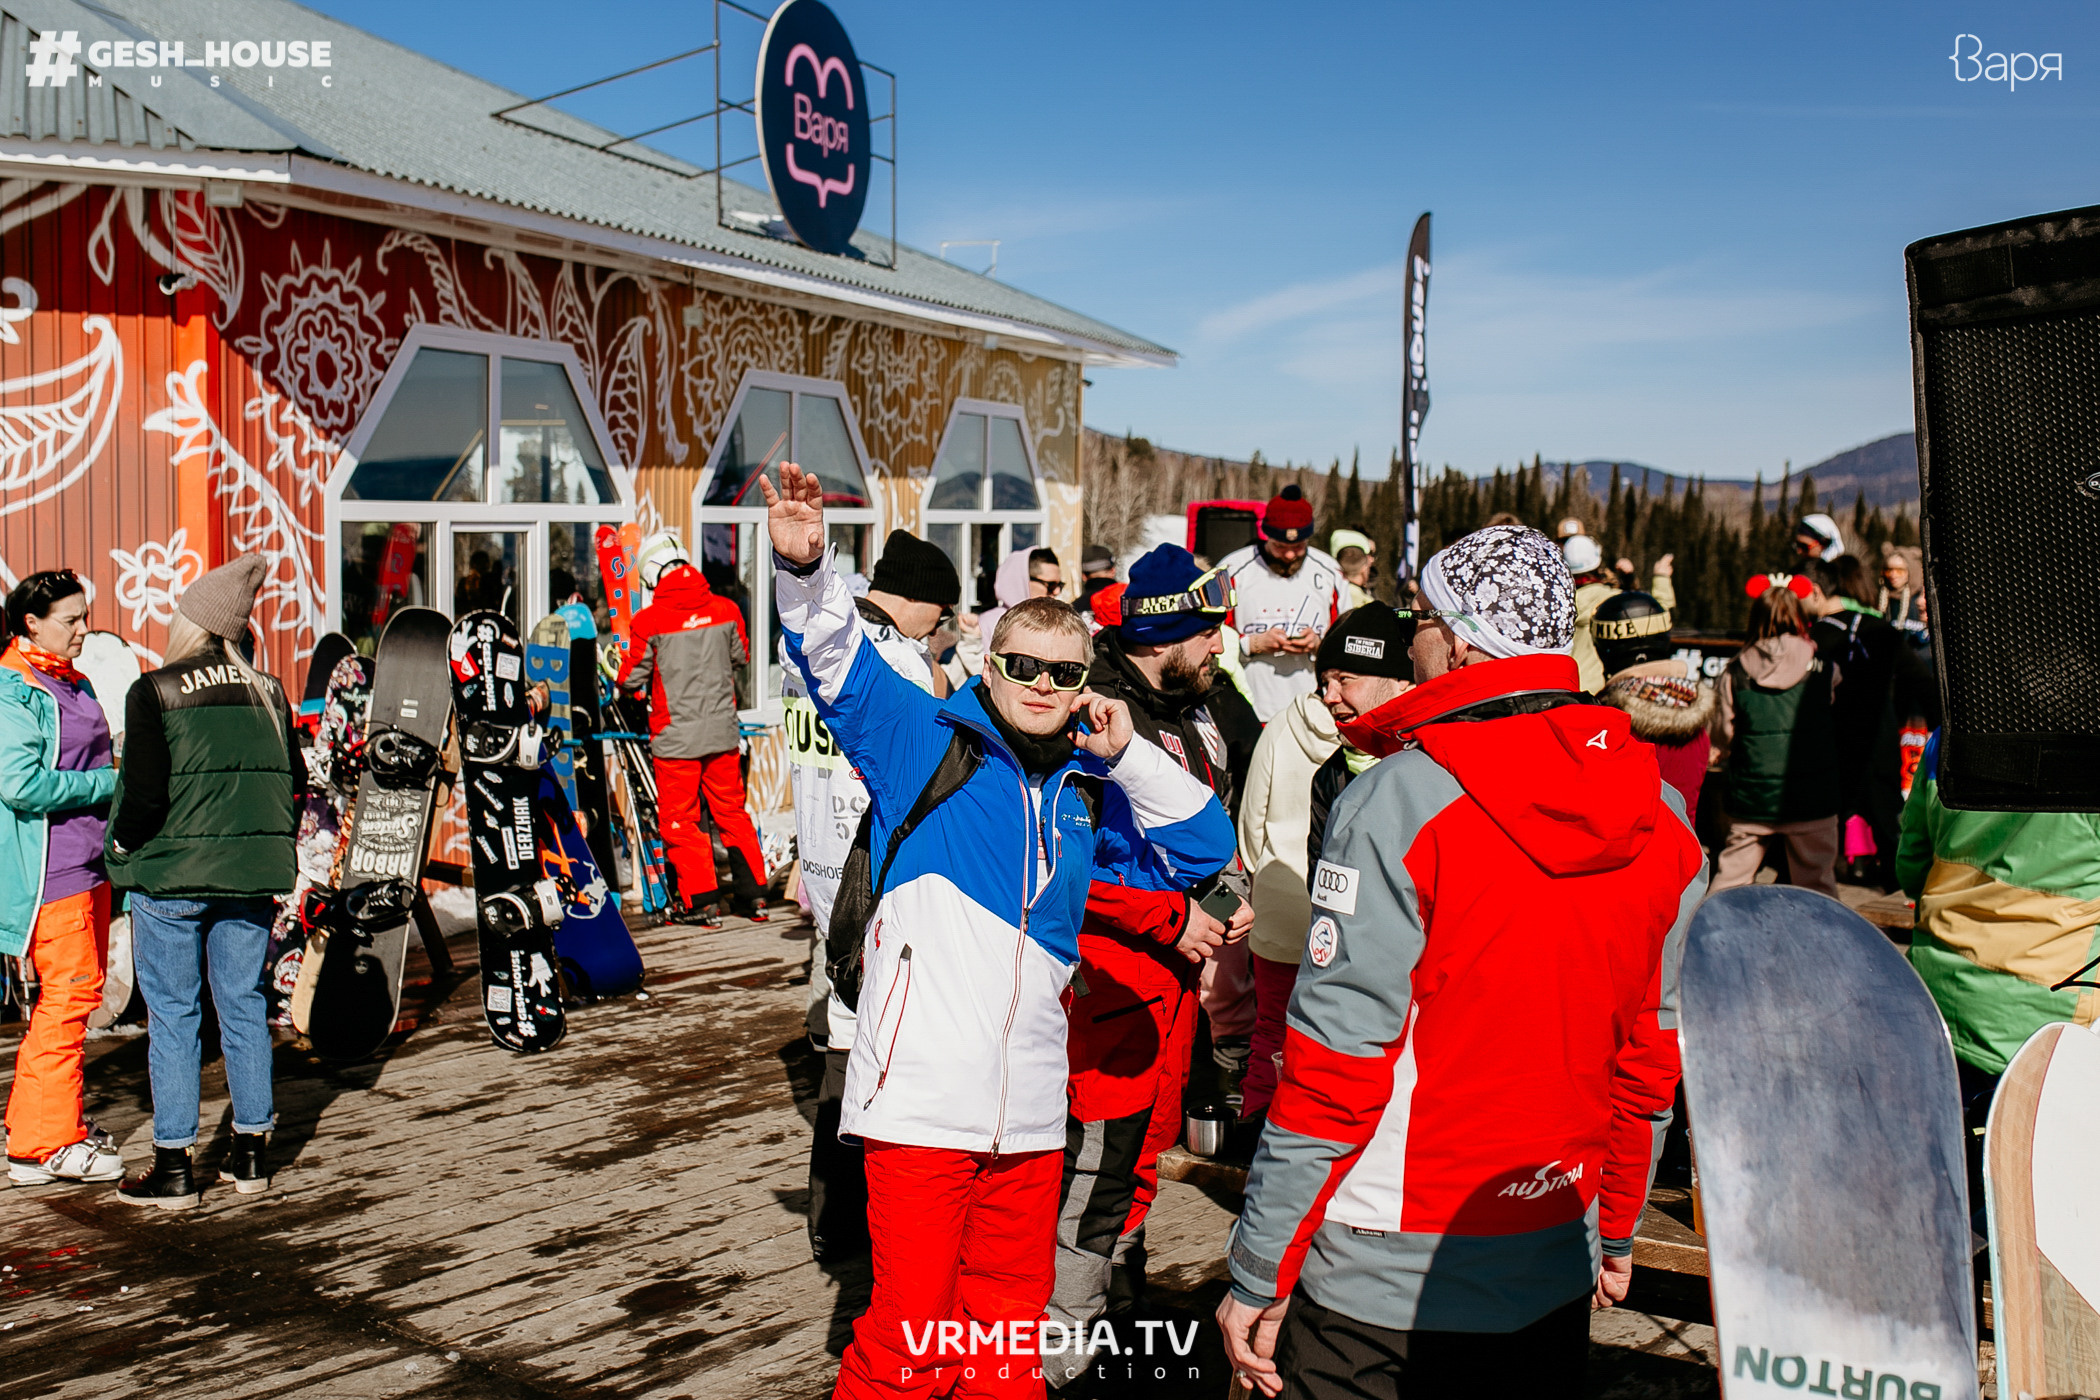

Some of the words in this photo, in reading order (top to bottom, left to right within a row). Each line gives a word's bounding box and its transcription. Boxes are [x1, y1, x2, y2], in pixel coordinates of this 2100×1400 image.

[794, 92, 849, 158] Варя
[1347, 643, 1381, 657] SIBERIA
[180, 664, 275, 694] JAMESN
[785, 708, 840, 756] OUS
[512, 796, 535, 860] DERZHAK
[351, 844, 414, 876] ARBOR
[1498, 1160, 1583, 1200] AUSTRIA
